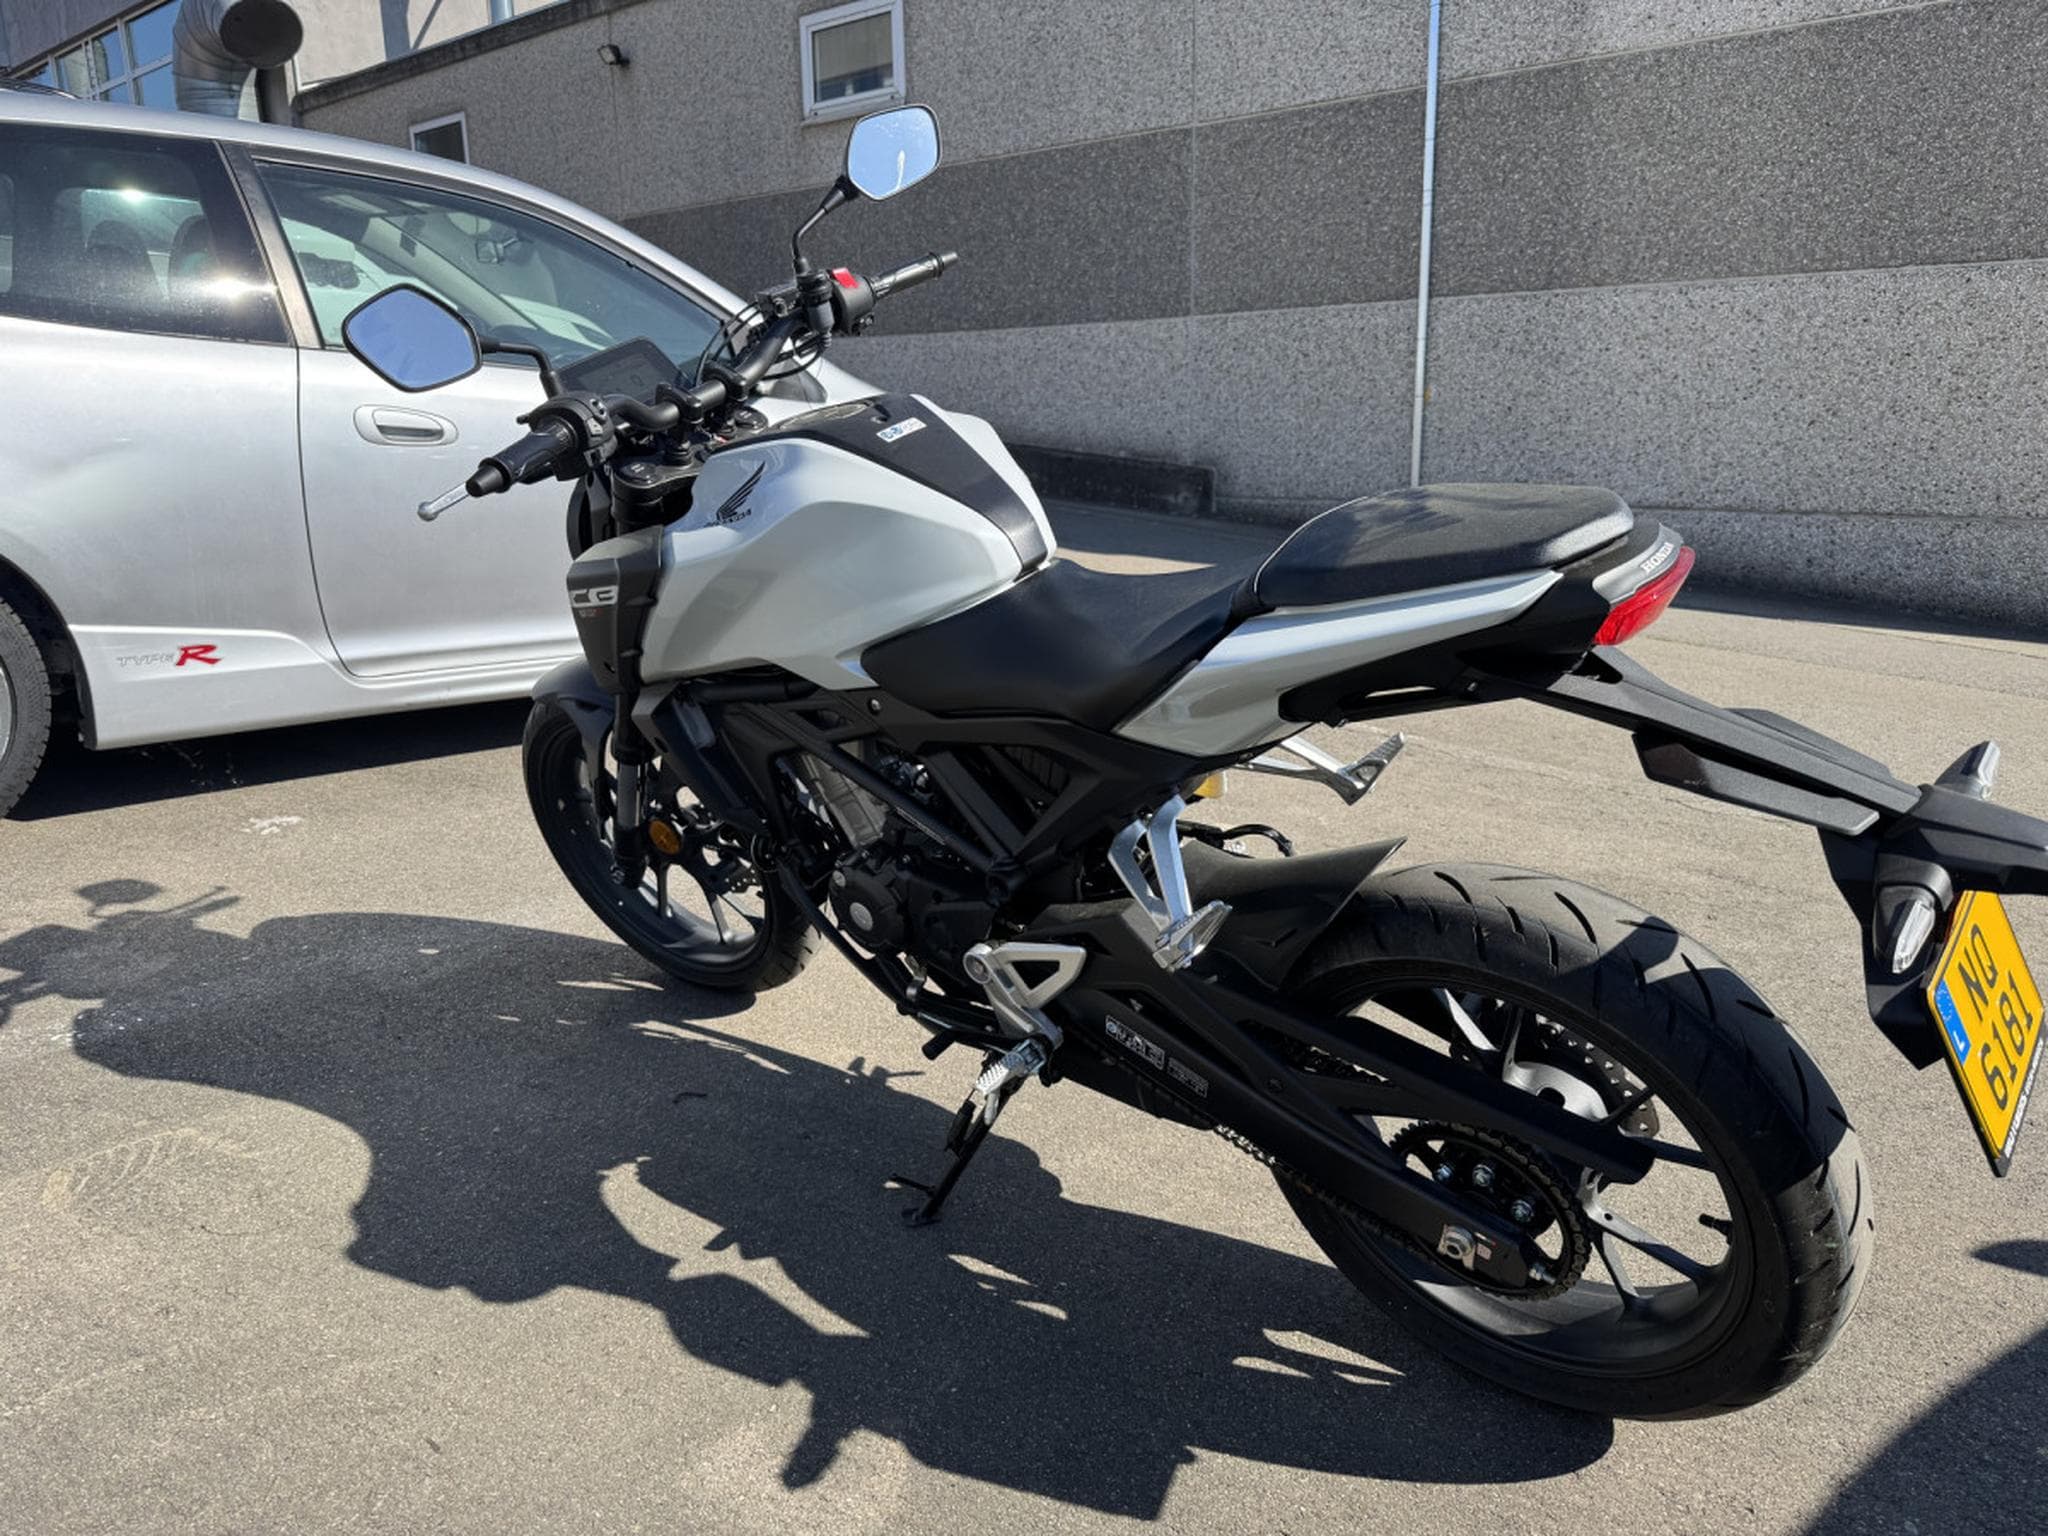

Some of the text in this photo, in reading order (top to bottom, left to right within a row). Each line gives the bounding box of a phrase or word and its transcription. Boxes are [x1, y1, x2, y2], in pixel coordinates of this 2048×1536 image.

[175, 644, 223, 667] R
[1957, 923, 1999, 1022] NQ
[1980, 969, 2034, 1112] 6181
